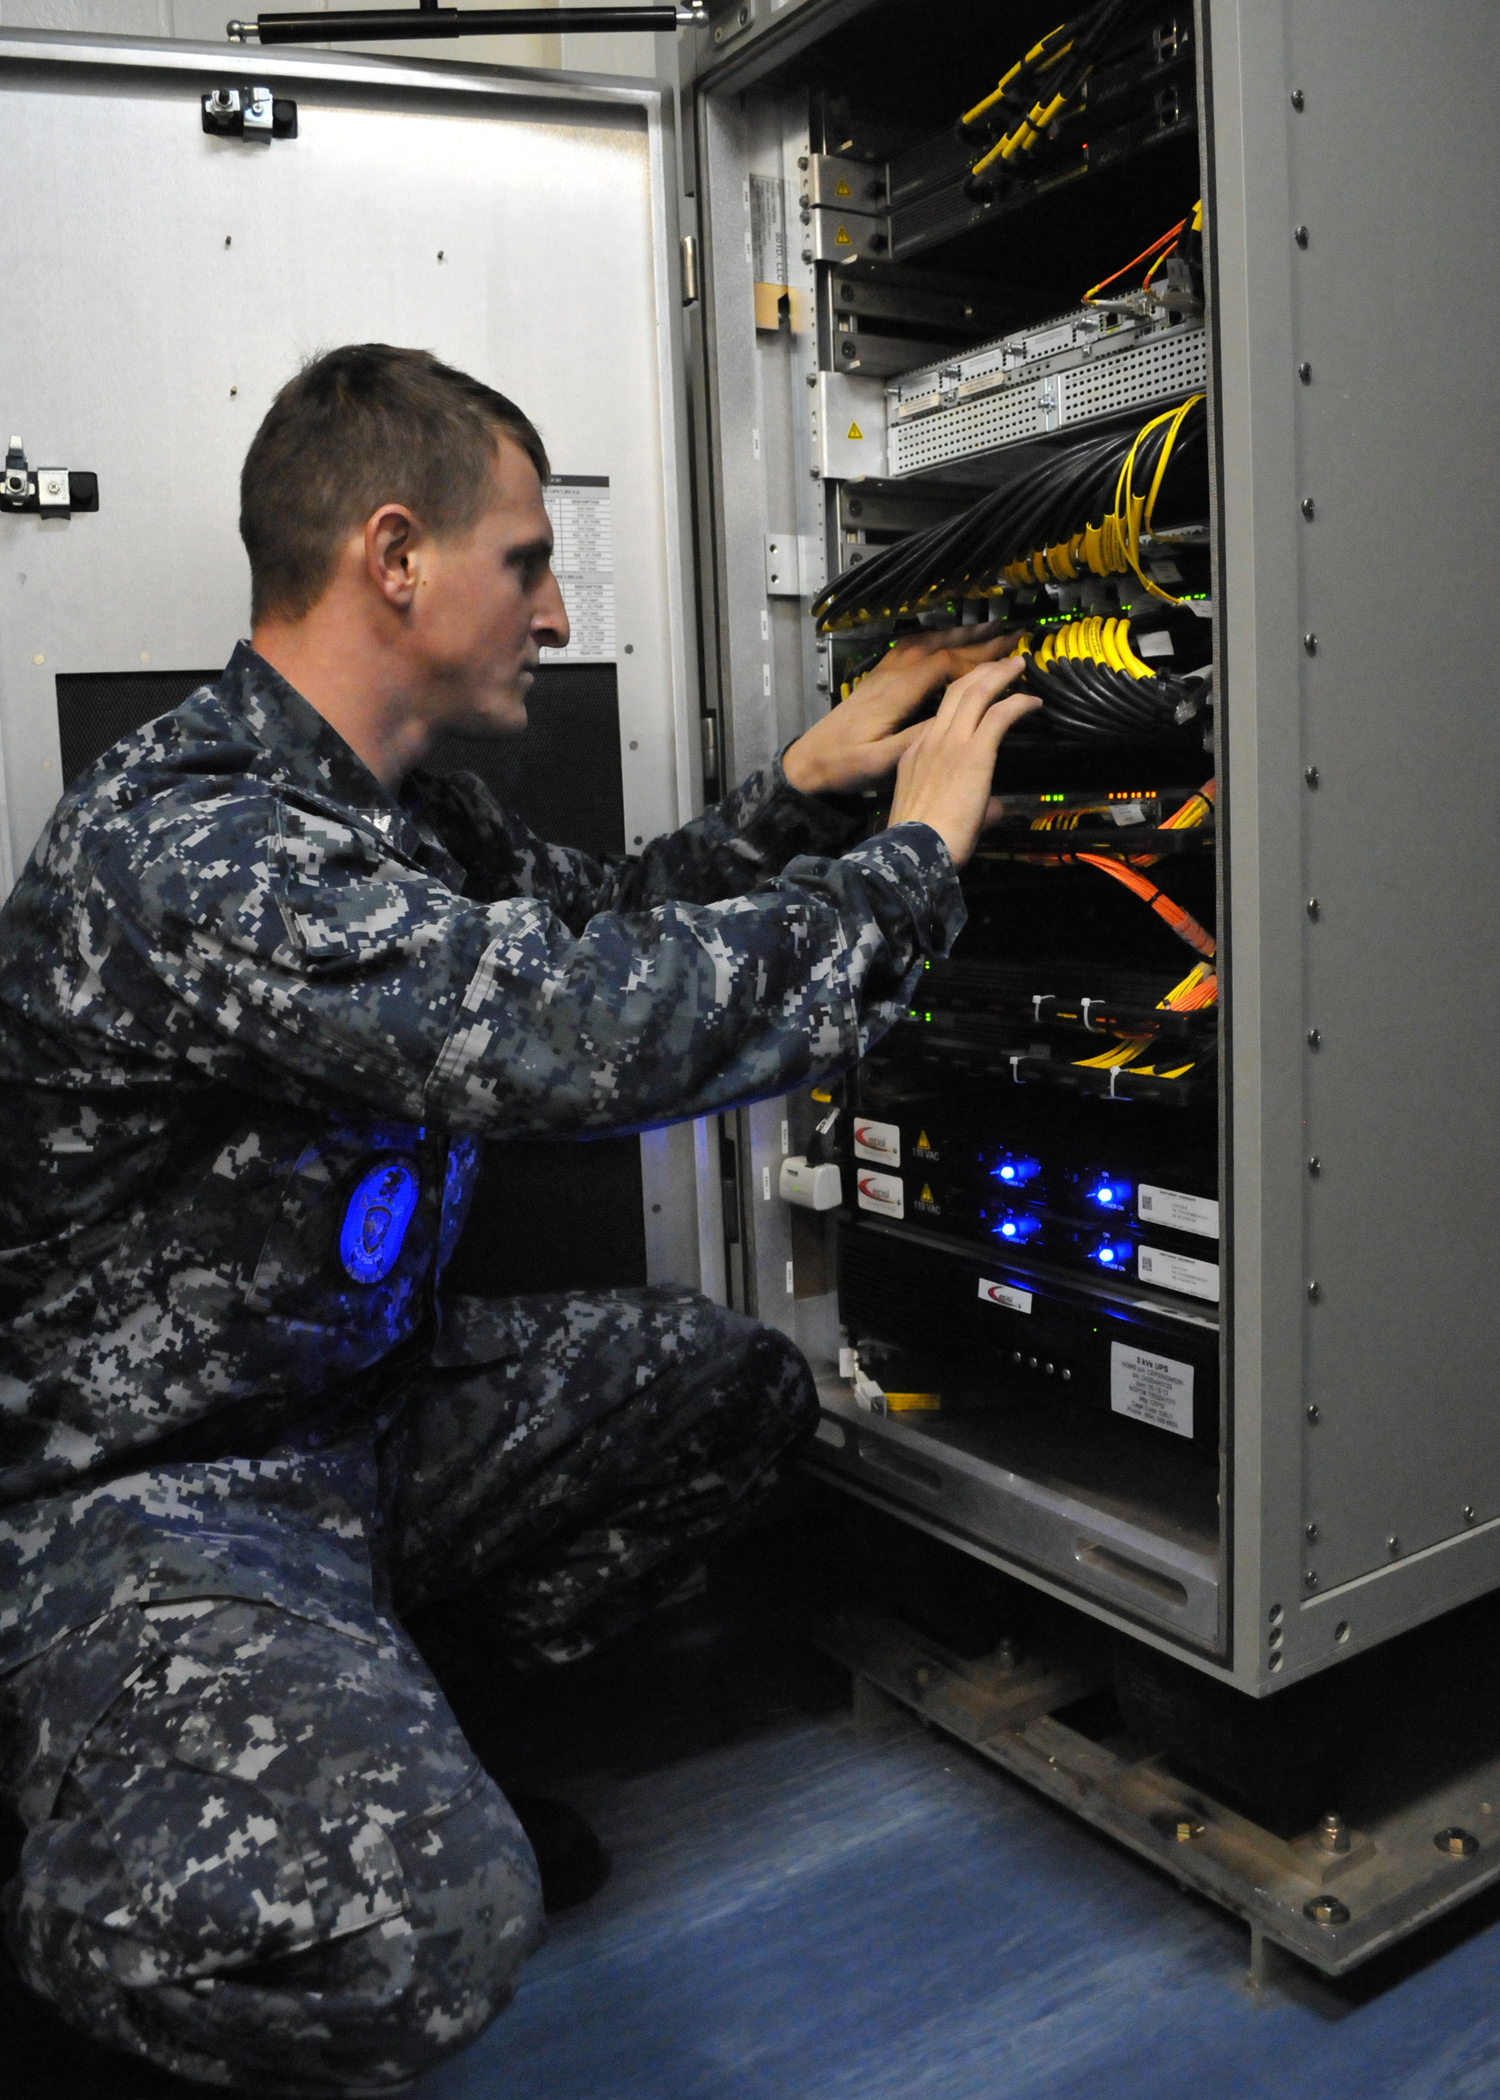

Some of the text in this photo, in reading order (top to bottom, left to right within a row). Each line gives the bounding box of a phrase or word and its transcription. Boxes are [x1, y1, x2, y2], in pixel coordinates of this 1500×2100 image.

[776, 262, 784, 282] LLC
[912, 1147, 940, 1161] 110 VAC
[914, 1200, 941, 1215] 110 VAC
[1102, 1231, 1111, 1239] ON
[1136, 1356, 1141, 1364] 3
[1154, 1362, 1169, 1373] UPS
